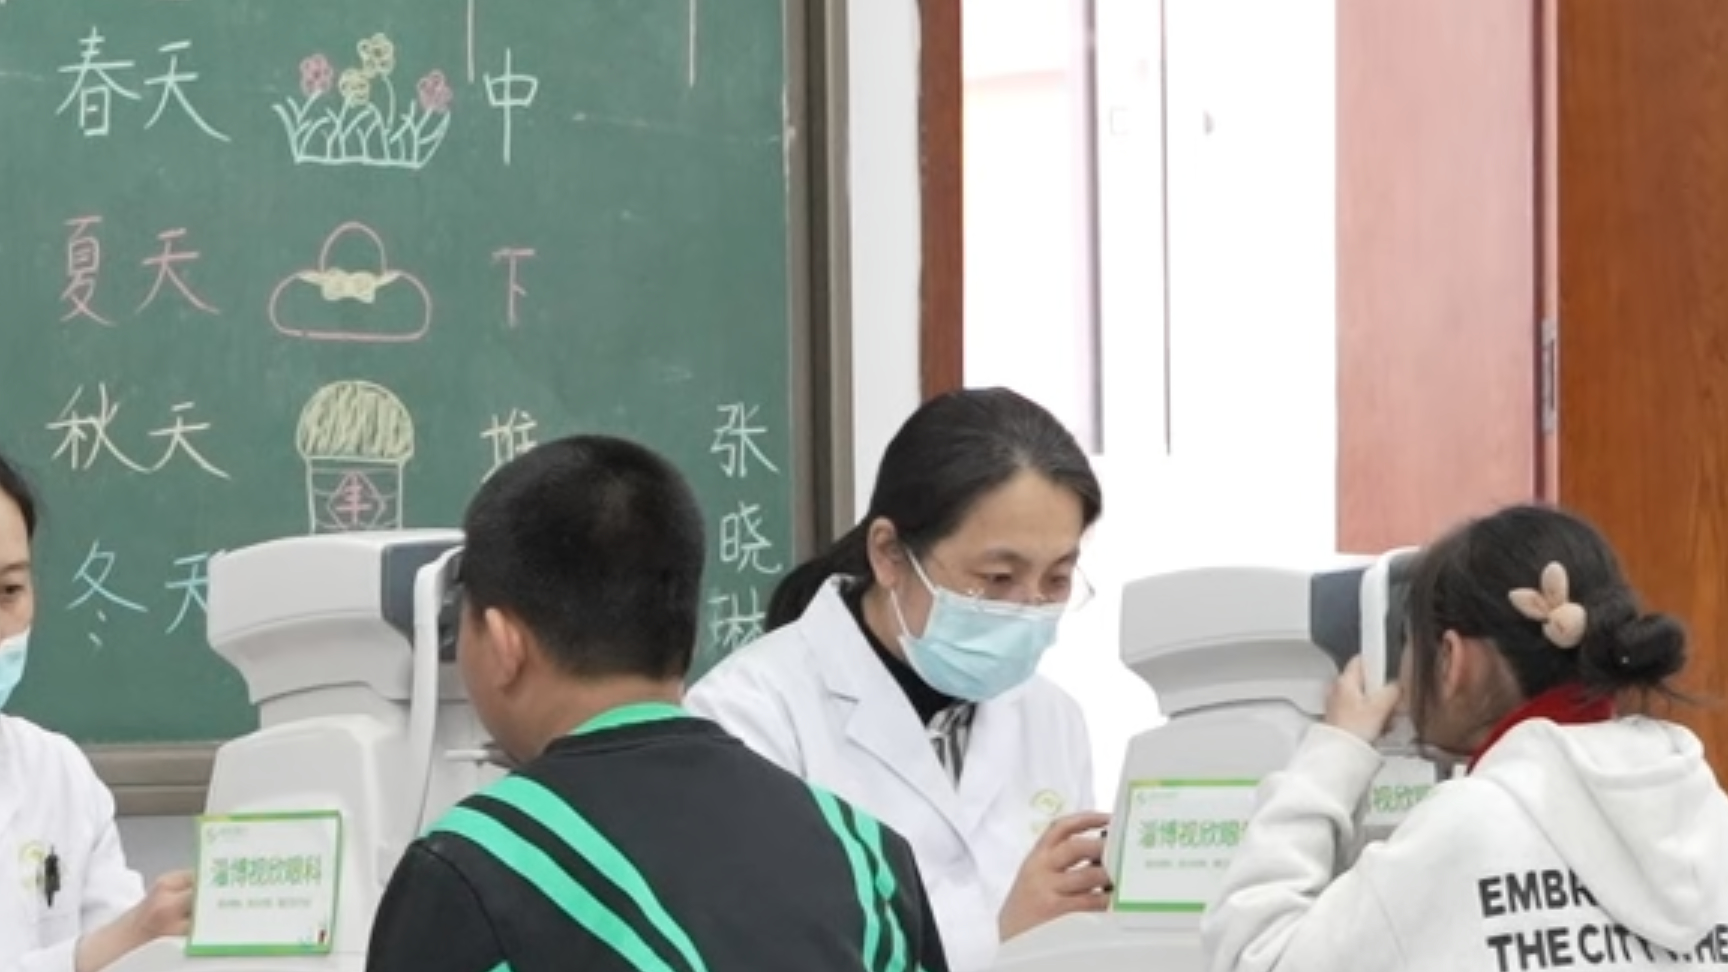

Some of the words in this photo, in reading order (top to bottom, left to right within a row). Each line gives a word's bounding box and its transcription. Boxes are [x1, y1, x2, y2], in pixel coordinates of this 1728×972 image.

[56, 26, 231, 141] 春天
[484, 48, 538, 165] 中
[60, 215, 221, 327] 夏天
[491, 248, 536, 327] 下
[45, 382, 231, 479] 秋天
[65, 539, 208, 647] 冬天
[1137, 819, 1248, 848] 淄博视欣眼
